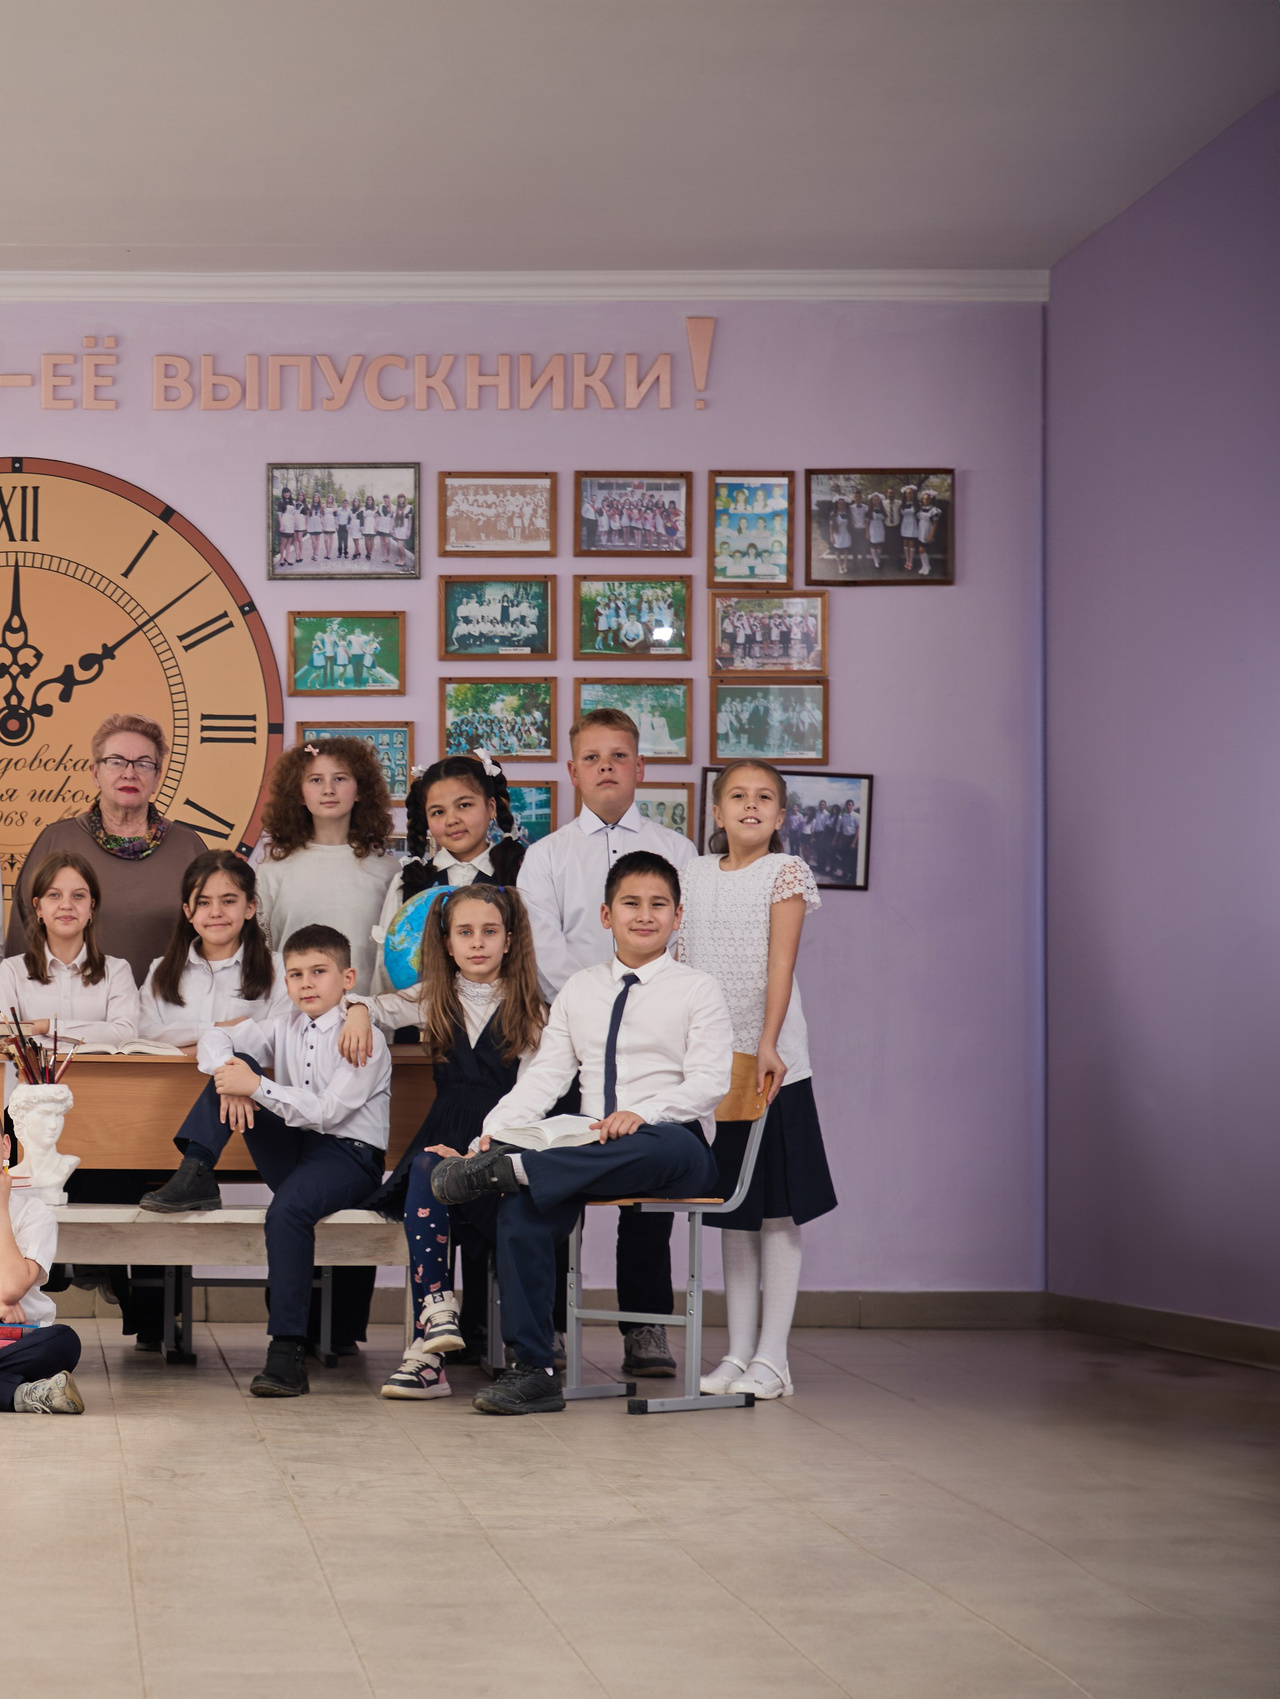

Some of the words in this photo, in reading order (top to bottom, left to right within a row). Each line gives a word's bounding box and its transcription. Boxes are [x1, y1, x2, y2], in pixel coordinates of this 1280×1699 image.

[153, 316, 716, 412] ВЫПУСКНИКИ!
[200, 713, 257, 746] III
[27, 775, 101, 803] школ
